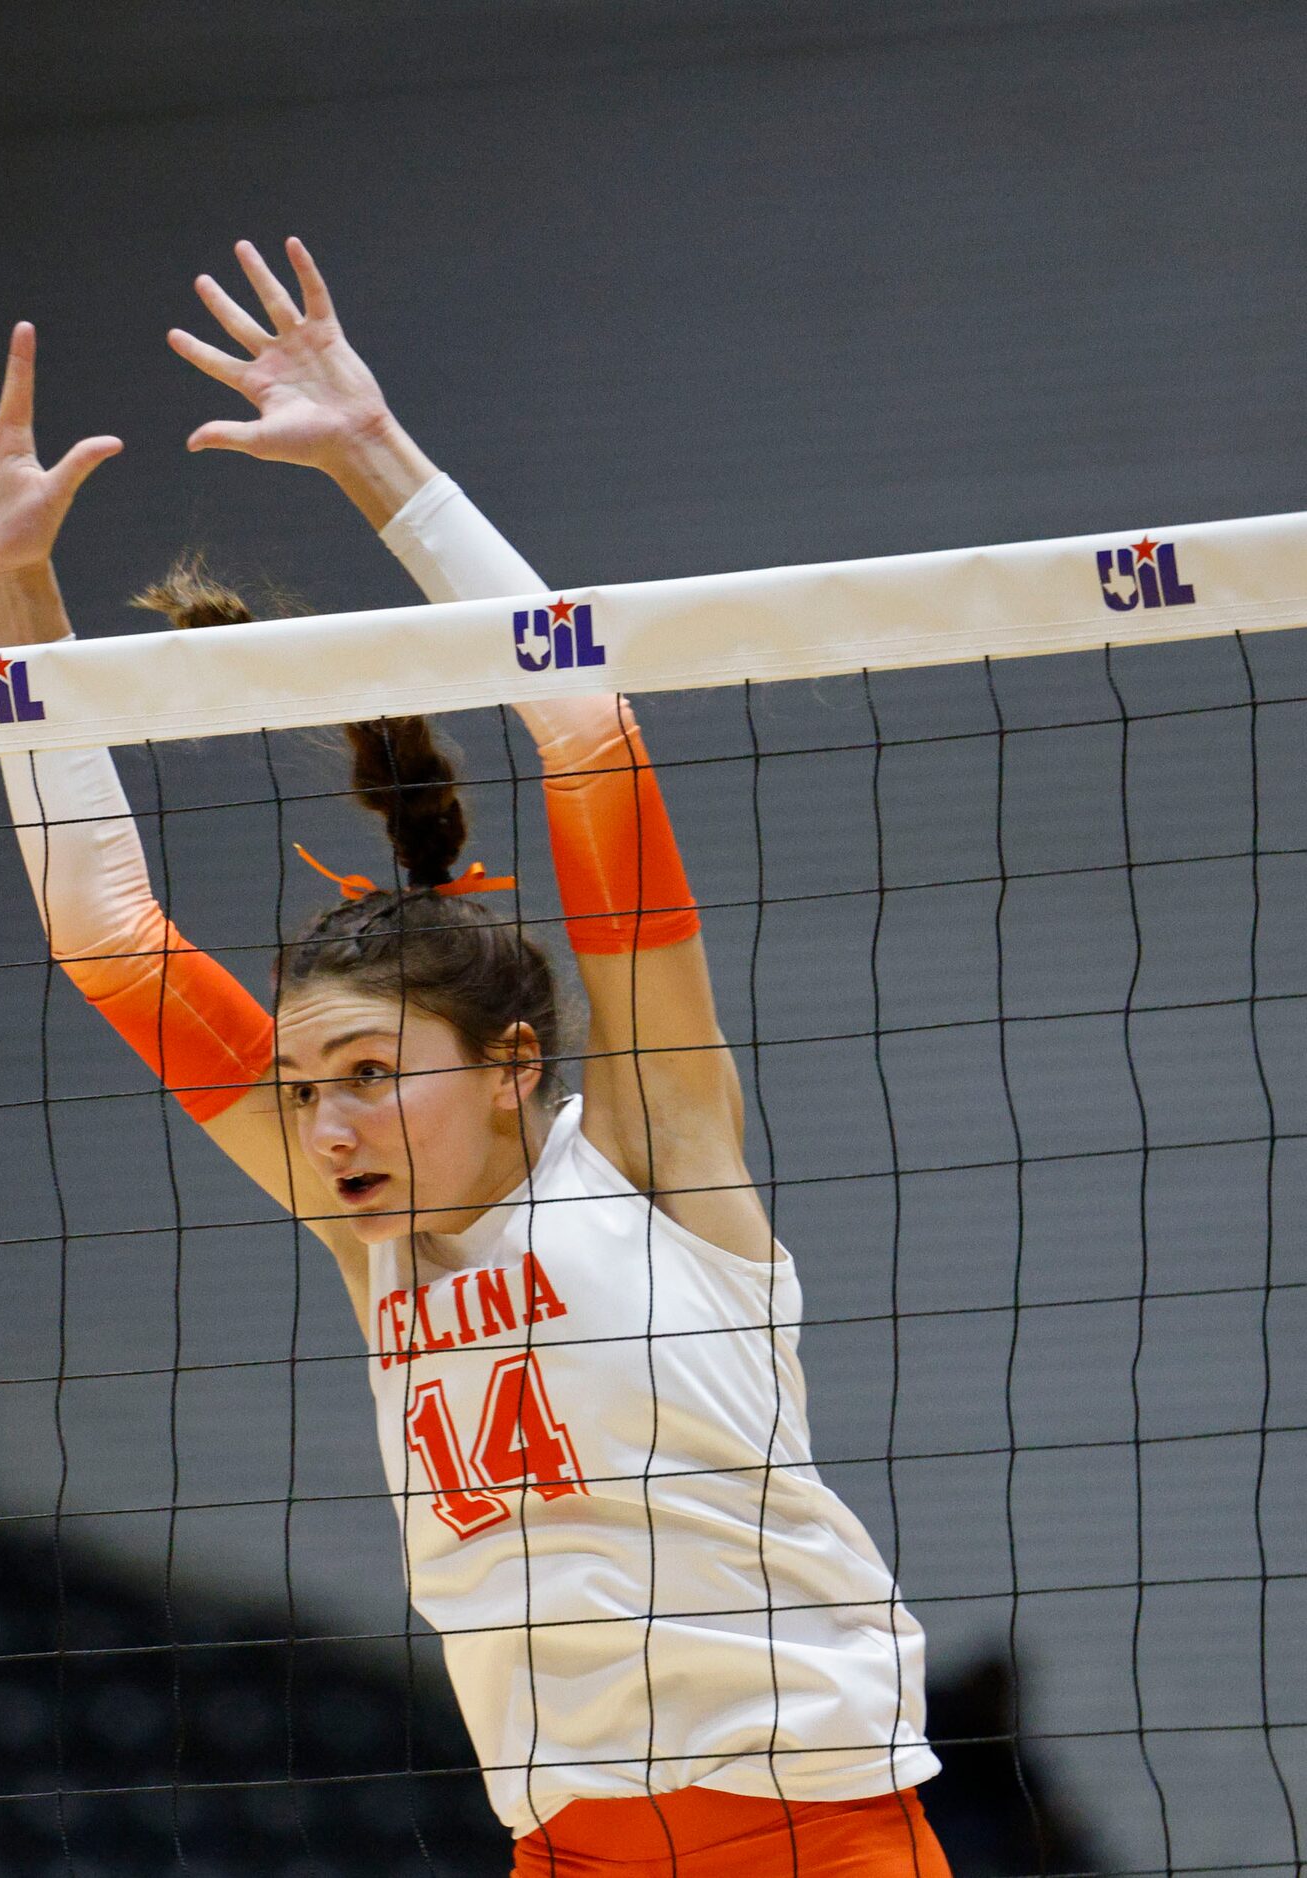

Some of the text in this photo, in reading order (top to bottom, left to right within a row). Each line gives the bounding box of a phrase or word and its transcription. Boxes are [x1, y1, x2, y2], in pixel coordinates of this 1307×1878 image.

[1096, 536, 1195, 611] UIL
[513, 597, 606, 672] UIL
[378, 1251, 567, 1370] CELINA
[405, 1350, 590, 1541] 14
